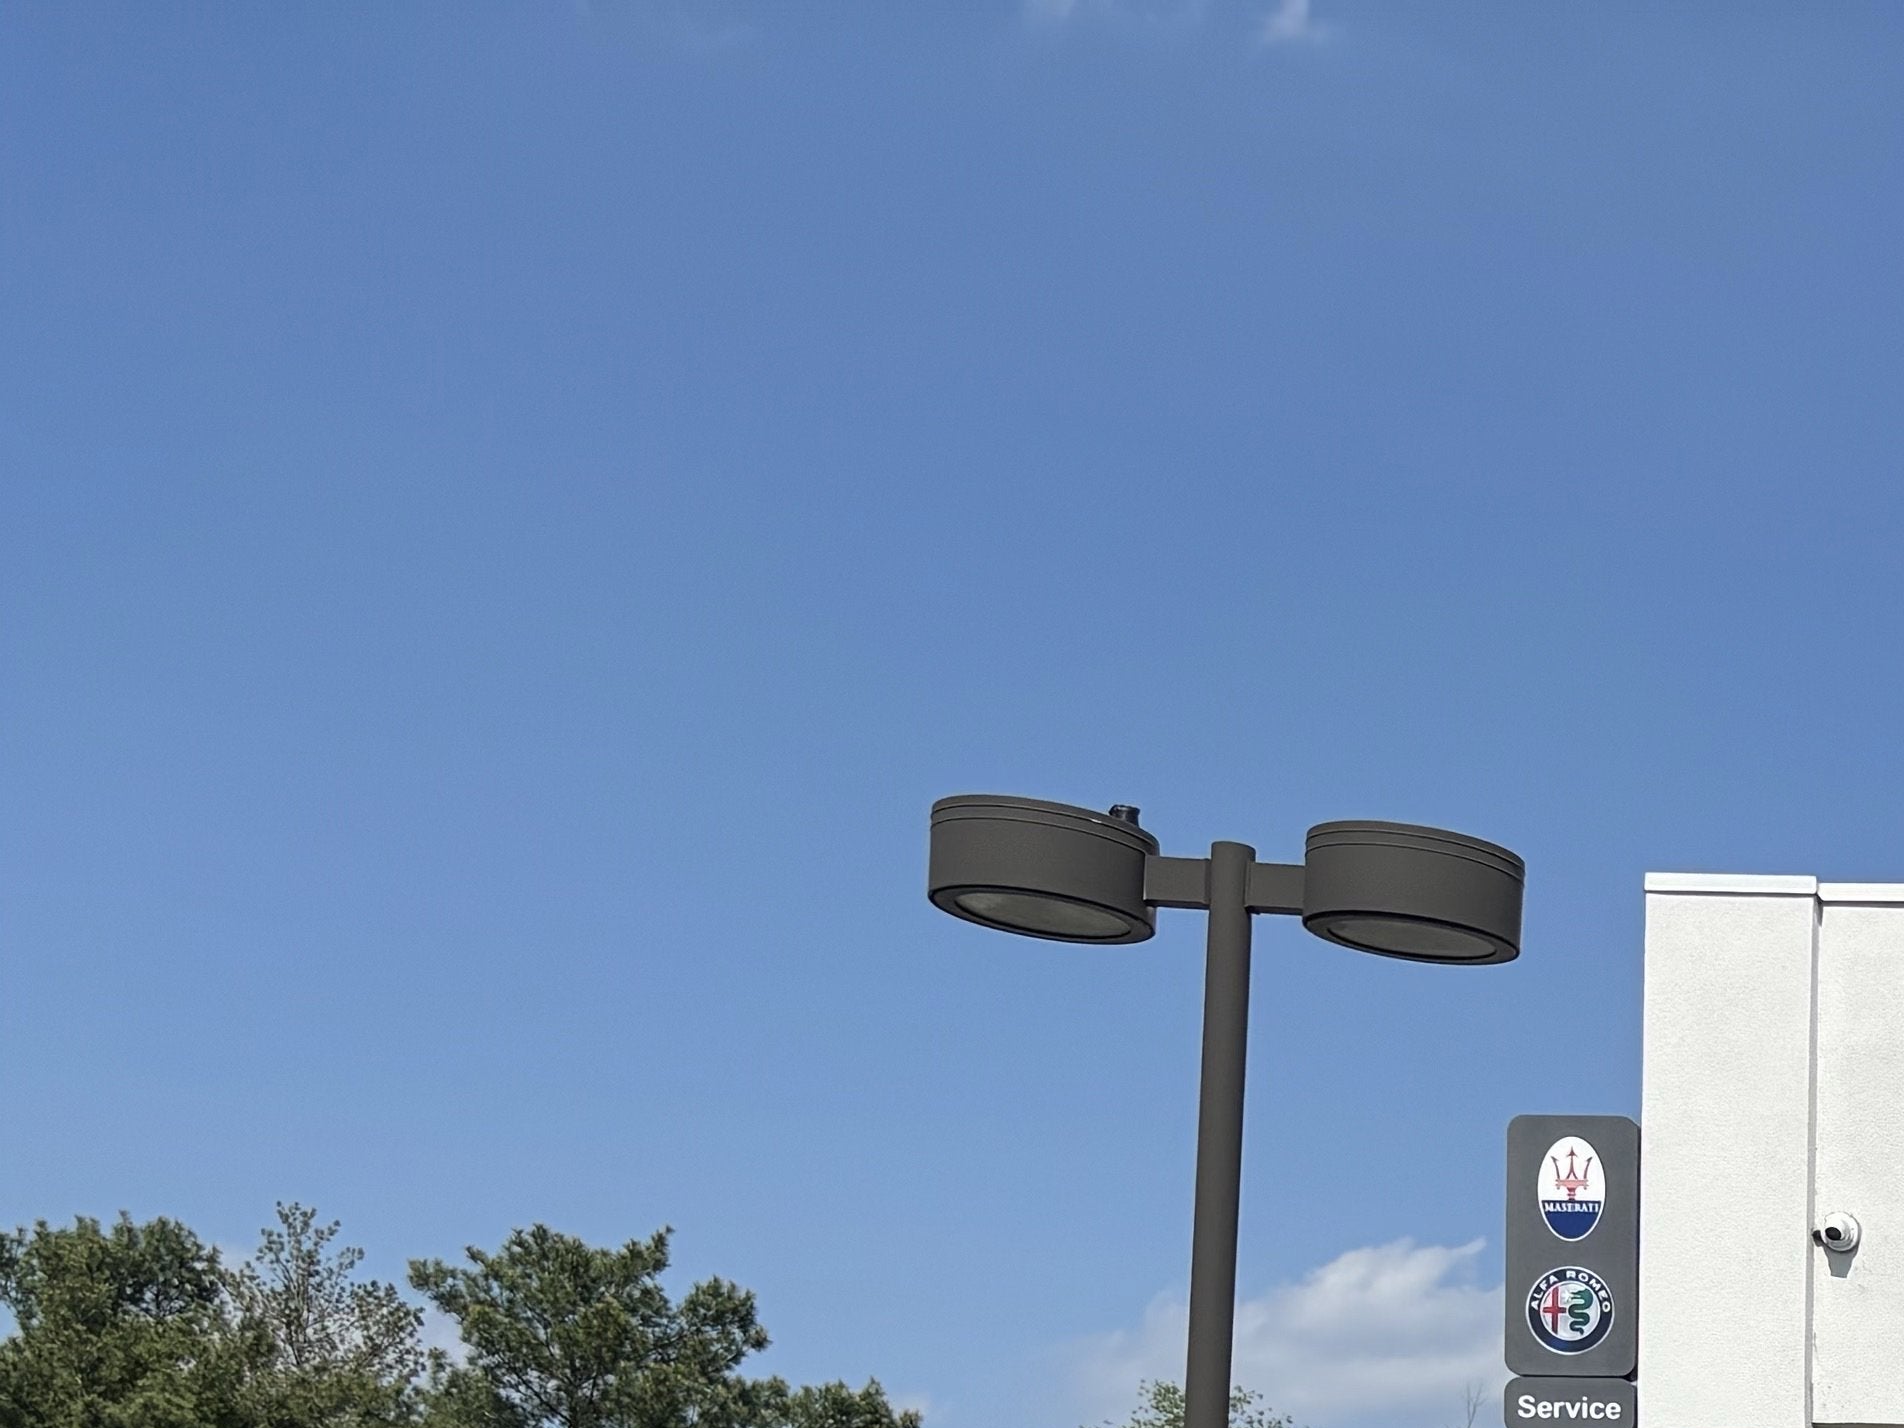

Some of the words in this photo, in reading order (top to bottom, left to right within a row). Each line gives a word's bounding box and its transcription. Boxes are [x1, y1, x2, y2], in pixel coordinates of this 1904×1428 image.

[1544, 1202, 1599, 1213] MASERATI
[1530, 1274, 1560, 1311] ALFA
[1565, 1270, 1612, 1313] ROMEO
[1517, 1394, 1622, 1420] Service
